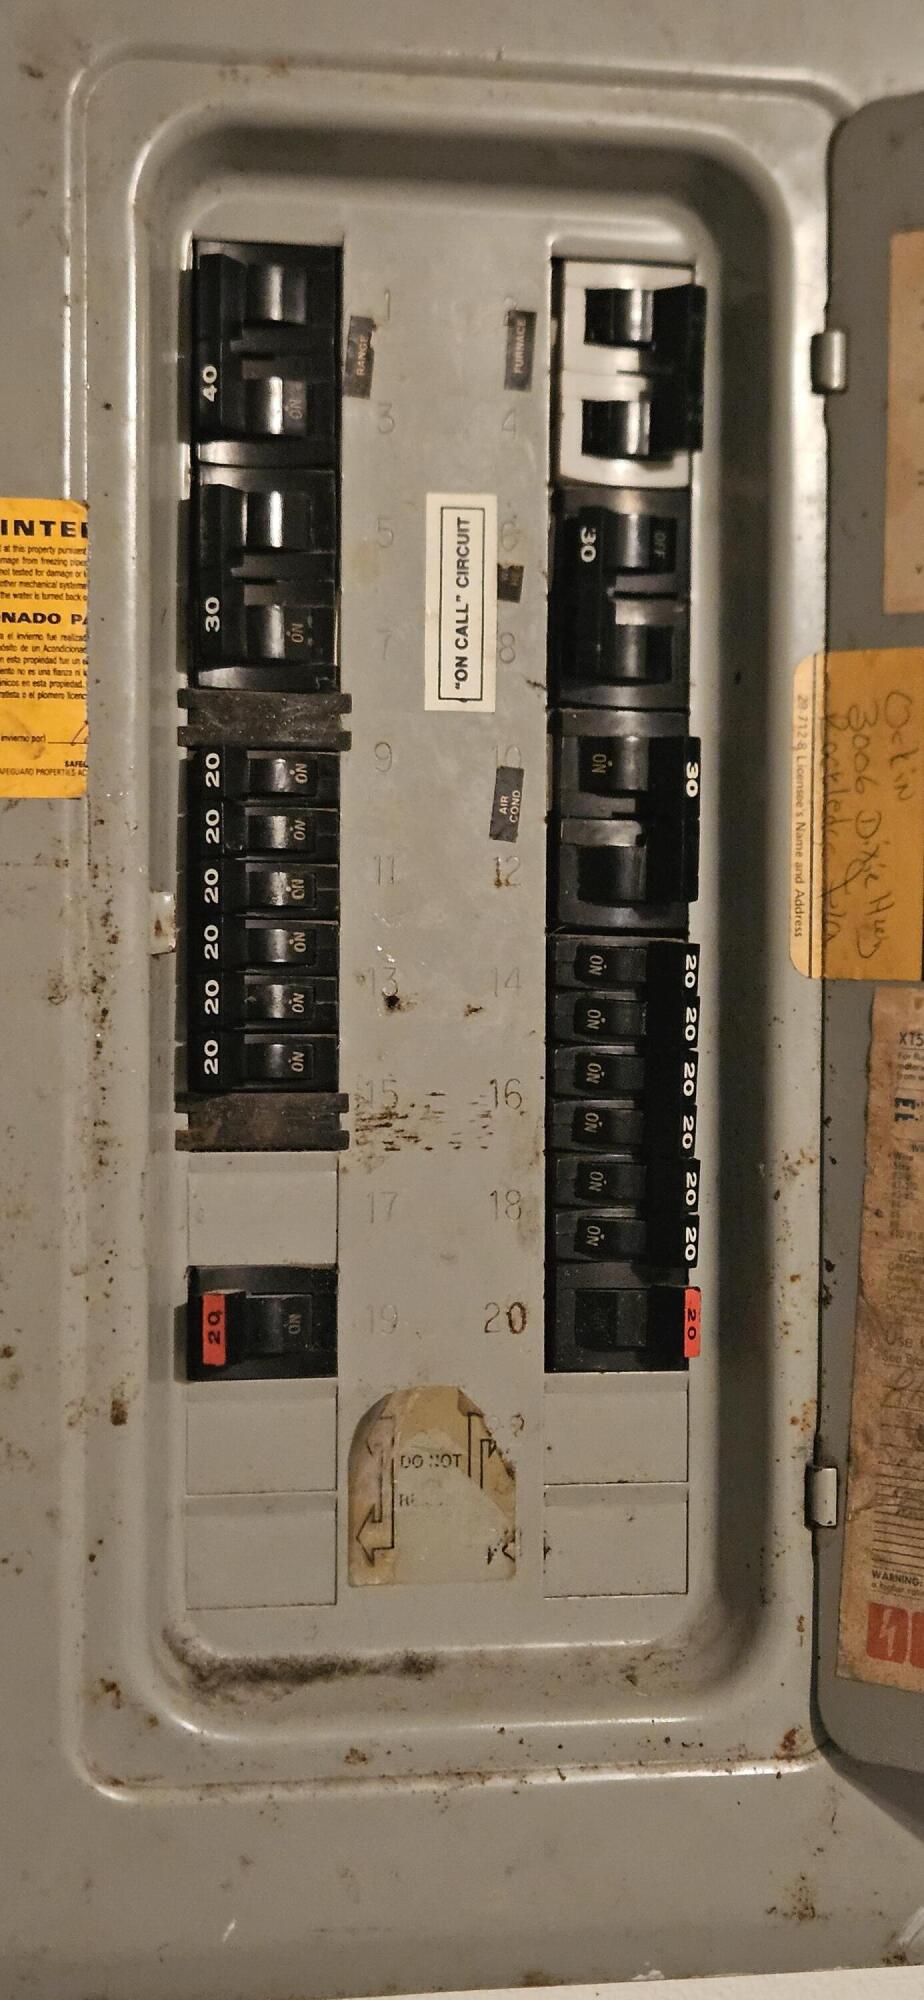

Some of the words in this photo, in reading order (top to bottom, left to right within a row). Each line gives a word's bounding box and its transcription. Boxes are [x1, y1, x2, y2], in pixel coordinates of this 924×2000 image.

[356, 335, 368, 376] RANGE
[513, 320, 527, 374] FURNACE
[202, 364, 218, 402] 40
[289, 401, 303, 420] ON
[377, 402, 395, 434] 3
[501, 407, 517, 440] 4
[377, 518, 394, 548] 5
[580, 525, 596, 563] 30
[28, 546, 55, 555] property
[456, 517, 470, 589] CIRCUIT
[205, 596, 220, 632] 30
[291, 623, 305, 642] ON
[499, 632, 516, 664] 8
[374, 741, 393, 772] 9
[848, 699, 880, 795] 3006
[205, 752, 220, 788] 20
[295, 763, 309, 784] ON
[592, 754, 607, 774] ON
[686, 762, 700, 797] 30
[796, 755, 808, 817] Licensee's
[499, 795, 509, 815] AIR
[509, 790, 521, 823] COND
[206, 809, 220, 844] 20
[294, 820, 307, 841] ON
[796, 822, 807, 858] Name
[204, 868, 219, 904] 20
[374, 855, 395, 886] 11
[493, 855, 521, 888] 12
[795, 862, 805, 886] and
[291, 879, 305, 900] ON
[794, 889, 806, 938] Address
[204, 924, 219, 960] 20
[294, 932, 307, 952] ON
[589, 955, 604, 976] ON
[685, 954, 697, 989] 20
[205, 979, 219, 1015] 20
[368, 966, 398, 1000] 13
[490, 966, 522, 999] 14
[292, 993, 305, 1013] ON
[587, 1009, 602, 1029] ON
[685, 1006, 698, 1041] 20
[204, 1039, 219, 1075] 20
[292, 1051, 305, 1072] ON
[586, 1062, 602, 1084] ON
[489, 1077, 523, 1111] 16
[683, 1062, 696, 1097] 20
[584, 1112, 600, 1133] ON
[682, 1115, 695, 1150] 20
[588, 1171, 604, 1192] ON
[685, 1172, 698, 1207] 20
[366, 1190, 398, 1224] 17
[489, 1189, 522, 1222] 18
[586, 1225, 602, 1247] ON
[685, 1226, 698, 1262] 20
[207, 1310, 223, 1345] 20
[288, 1314, 302, 1335] ON
[366, 1303, 398, 1335] 19
[484, 1301, 528, 1335] 20
[688, 1308, 698, 1341] 20
[885, 1330, 912, 1348] Use
[400, 1454, 424, 1469] DO
[871, 1569, 923, 1587] WARNING:
